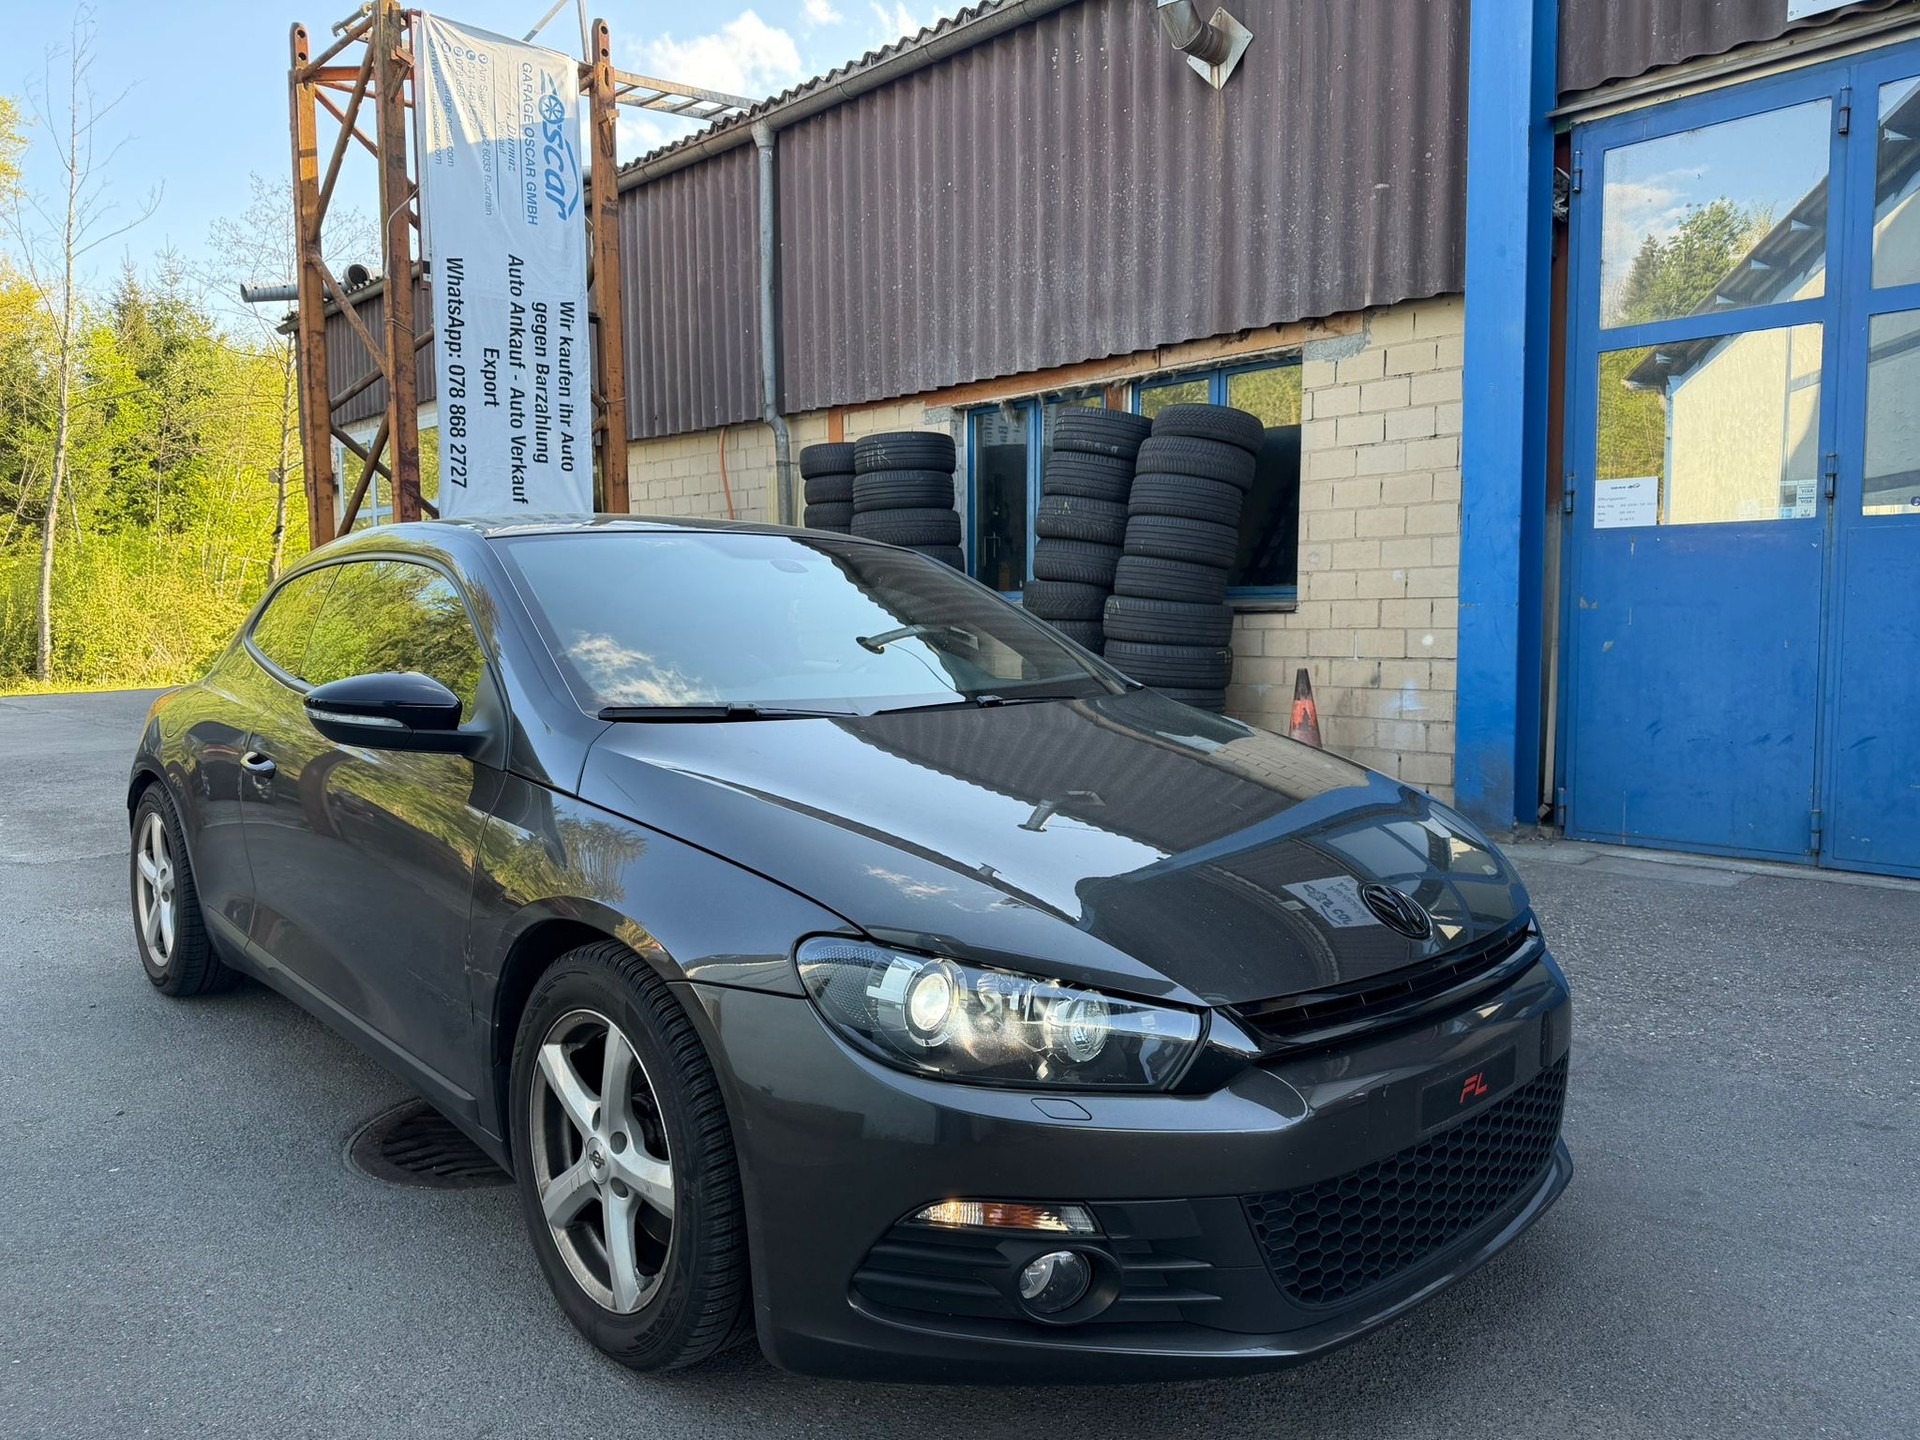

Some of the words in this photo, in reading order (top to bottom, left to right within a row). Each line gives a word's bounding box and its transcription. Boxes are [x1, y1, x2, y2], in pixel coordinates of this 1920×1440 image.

[522, 62, 534, 124] GARAGE
[498, 121, 507, 154] Verkauf
[506, 120, 517, 172] Durmaz
[524, 127, 536, 179] OSCAR
[482, 149, 491, 172] 6033
[484, 174, 493, 216] Buchrain
[526, 181, 538, 225] GMBH
[508, 254, 524, 297] Auto
[444, 257, 465, 359] WhatsApp:
[532, 302, 548, 357] gegen
[559, 301, 575, 329] Wir
[508, 301, 526, 369] Ankauf
[448, 365, 466, 399] 078
[480, 347, 500, 407] Export
[559, 335, 574, 397] kaufen
[449, 404, 467, 439] 868
[509, 387, 525, 429] Auto
[534, 361, 552, 464] Barzahlung
[559, 403, 574, 428] ihr
[450, 443, 467, 489] 2727
[510, 435, 528, 504] Verkauf
[560, 433, 574, 472] Auto
